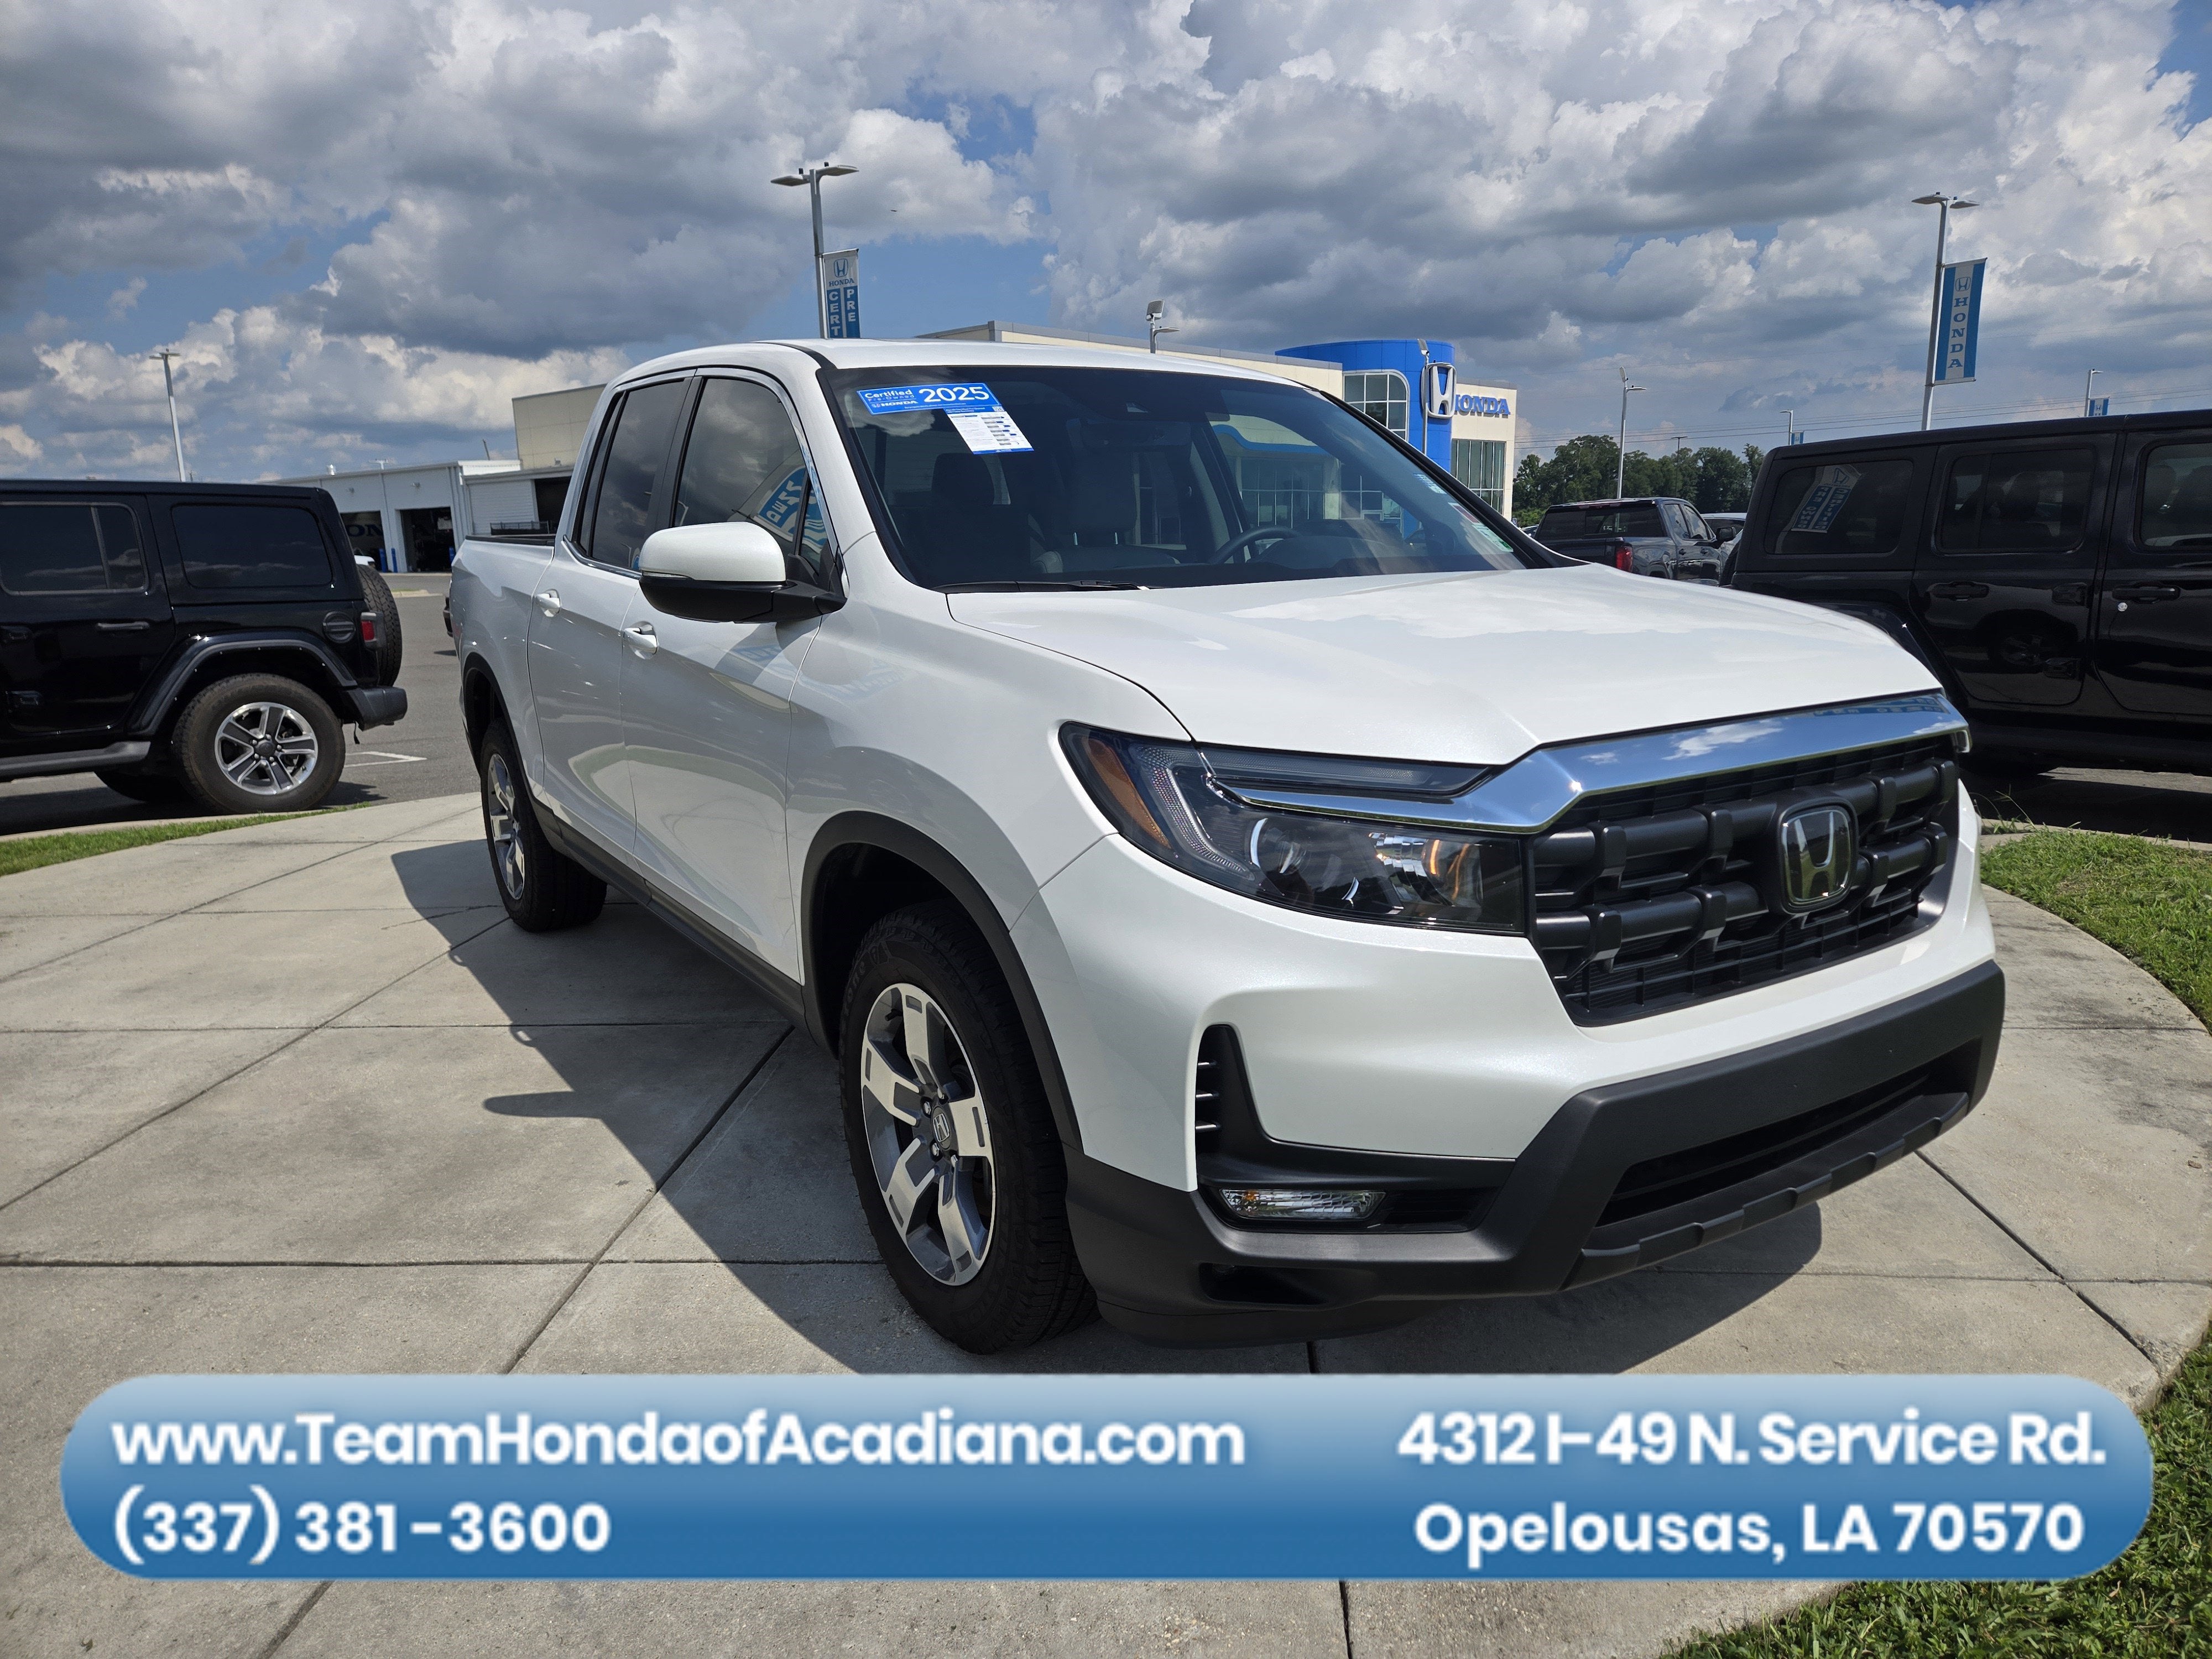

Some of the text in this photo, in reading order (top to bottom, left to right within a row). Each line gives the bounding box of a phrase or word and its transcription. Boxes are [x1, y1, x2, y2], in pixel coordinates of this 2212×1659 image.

[829, 278, 854, 286] HONDA
[847, 289, 856, 322] PRE
[1948, 297, 1969, 368] HONDA
[864, 389, 913, 398] Certified
[919, 387, 989, 403] 2025
